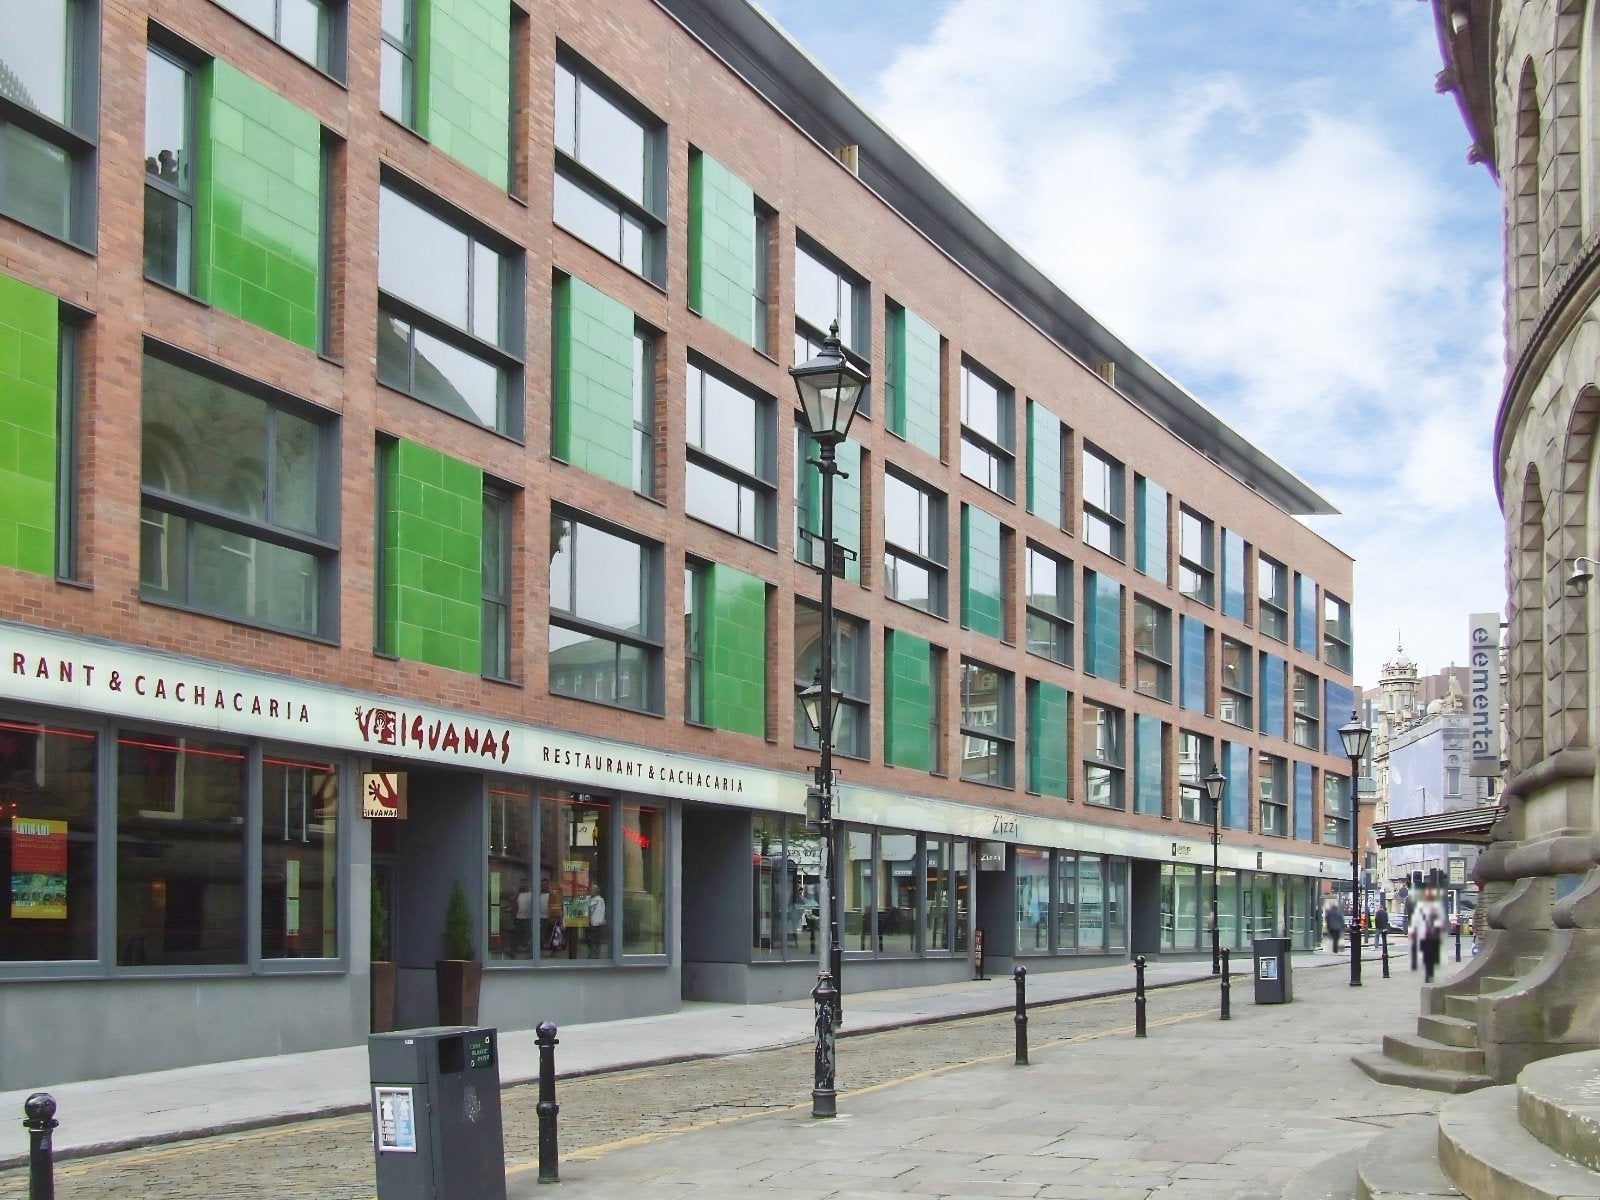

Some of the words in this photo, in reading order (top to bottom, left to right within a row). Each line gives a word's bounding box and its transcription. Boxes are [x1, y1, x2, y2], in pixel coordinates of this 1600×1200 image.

[13, 652, 94, 686] RANT
[109, 671, 121, 692] &
[135, 675, 309, 722] CACHACARIA
[1472, 627, 1497, 761] elemental
[401, 712, 510, 764] IGUANAS
[543, 746, 642, 777] RESTAURANT
[648, 765, 655, 780] &
[660, 767, 743, 793] CACHACARIA
[993, 815, 1018, 838] Zizzi
